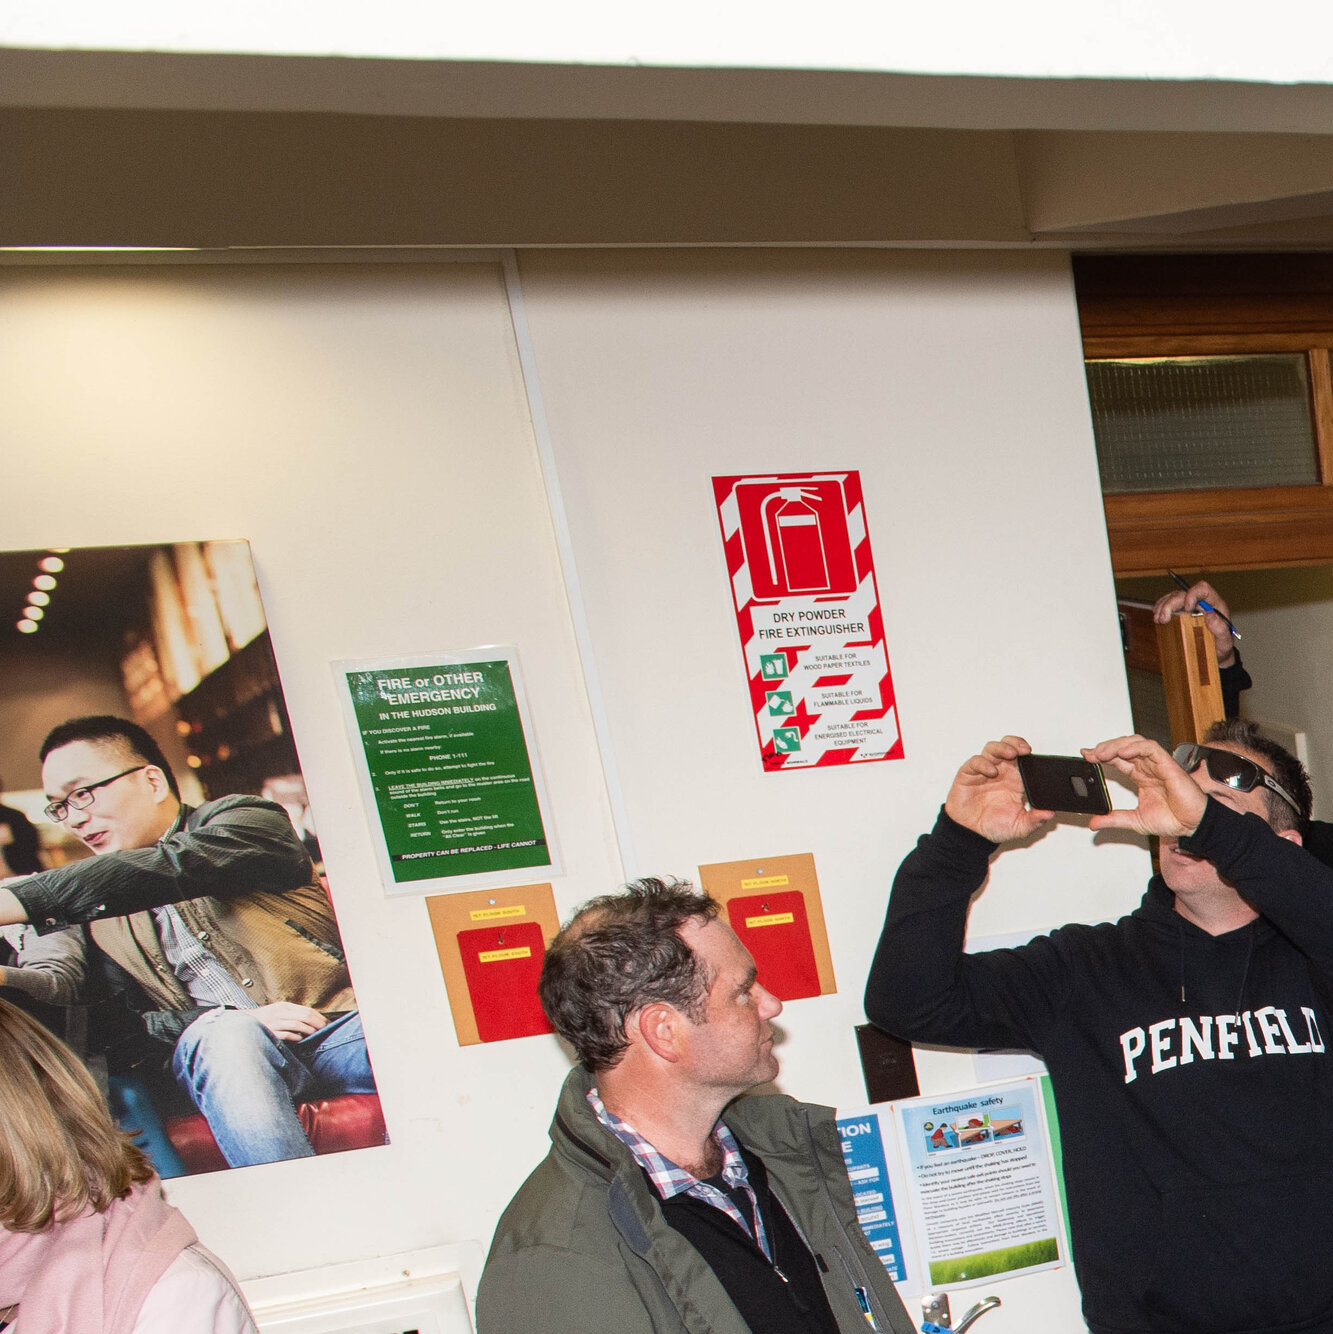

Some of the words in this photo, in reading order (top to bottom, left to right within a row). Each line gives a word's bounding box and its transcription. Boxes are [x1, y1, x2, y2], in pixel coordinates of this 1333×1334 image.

[773, 612, 795, 623] DRY
[799, 609, 846, 621] POWDER
[759, 628, 783, 639] FIRE
[786, 623, 864, 637] EXTINGUISHER
[377, 677, 412, 690] FIRE
[415, 679, 430, 687] or
[433, 671, 484, 685] OTHER
[388, 687, 480, 705] EMERGENCY
[391, 711, 410, 719] THE
[412, 708, 451, 717] HUDSON
[453, 704, 496, 714] BUILDING
[834, 738, 866, 746] EQUIPMENT
[402, 852, 435, 860] PROPERTY
[460, 845, 493, 853] REPLACED
[511, 840, 536, 848] CANNOT
[1119, 1006, 1325, 1084] PENFIELD
[932, 1101, 977, 1115] Earthquake
[980, 1097, 1003, 1106] safety
